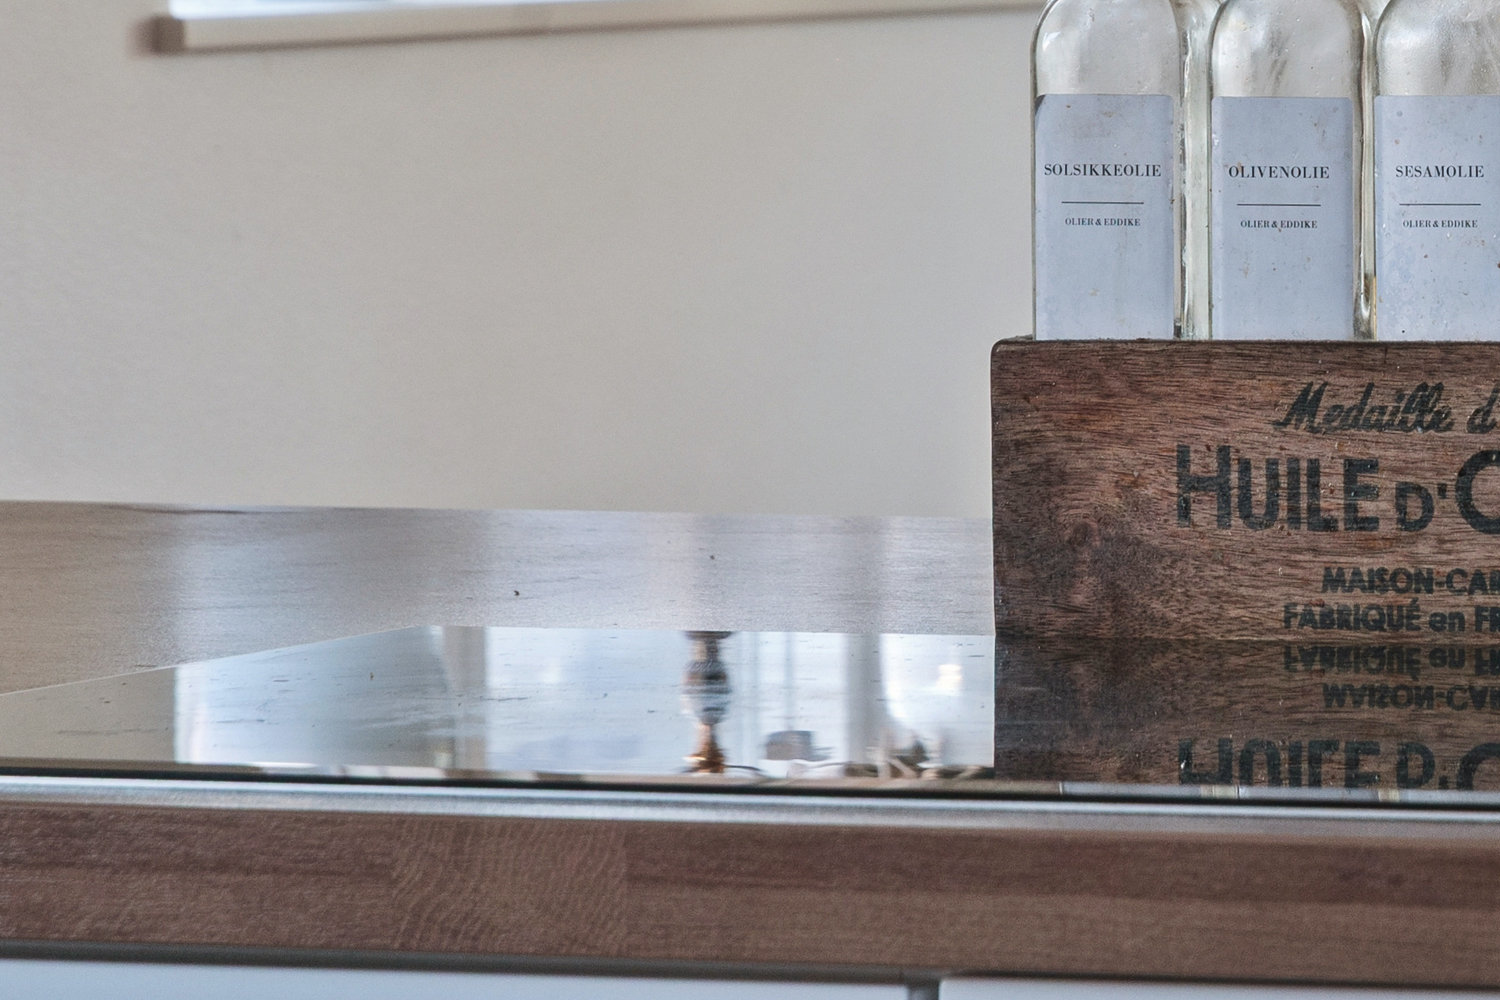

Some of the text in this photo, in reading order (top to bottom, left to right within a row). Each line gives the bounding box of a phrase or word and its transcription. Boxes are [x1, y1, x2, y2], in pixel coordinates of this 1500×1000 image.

[1043, 163, 1162, 178] SOLSIKKEOLIE
[1227, 164, 1330, 180] OLIVENOLIE
[1394, 164, 1485, 179] SESAMOLIE
[1064, 216, 1094, 228] OLIER
[1103, 216, 1141, 228] EDDIKE
[1240, 219, 1271, 230] OLIER
[1280, 219, 1318, 230] EDDIKE
[1402, 218, 1432, 230] OLIER
[1441, 218, 1478, 230] EDDIKE
[1176, 445, 1379, 532] HUILE
[1283, 598, 1420, 632] FABRIQUÉ
[1428, 611, 1465, 632] en
